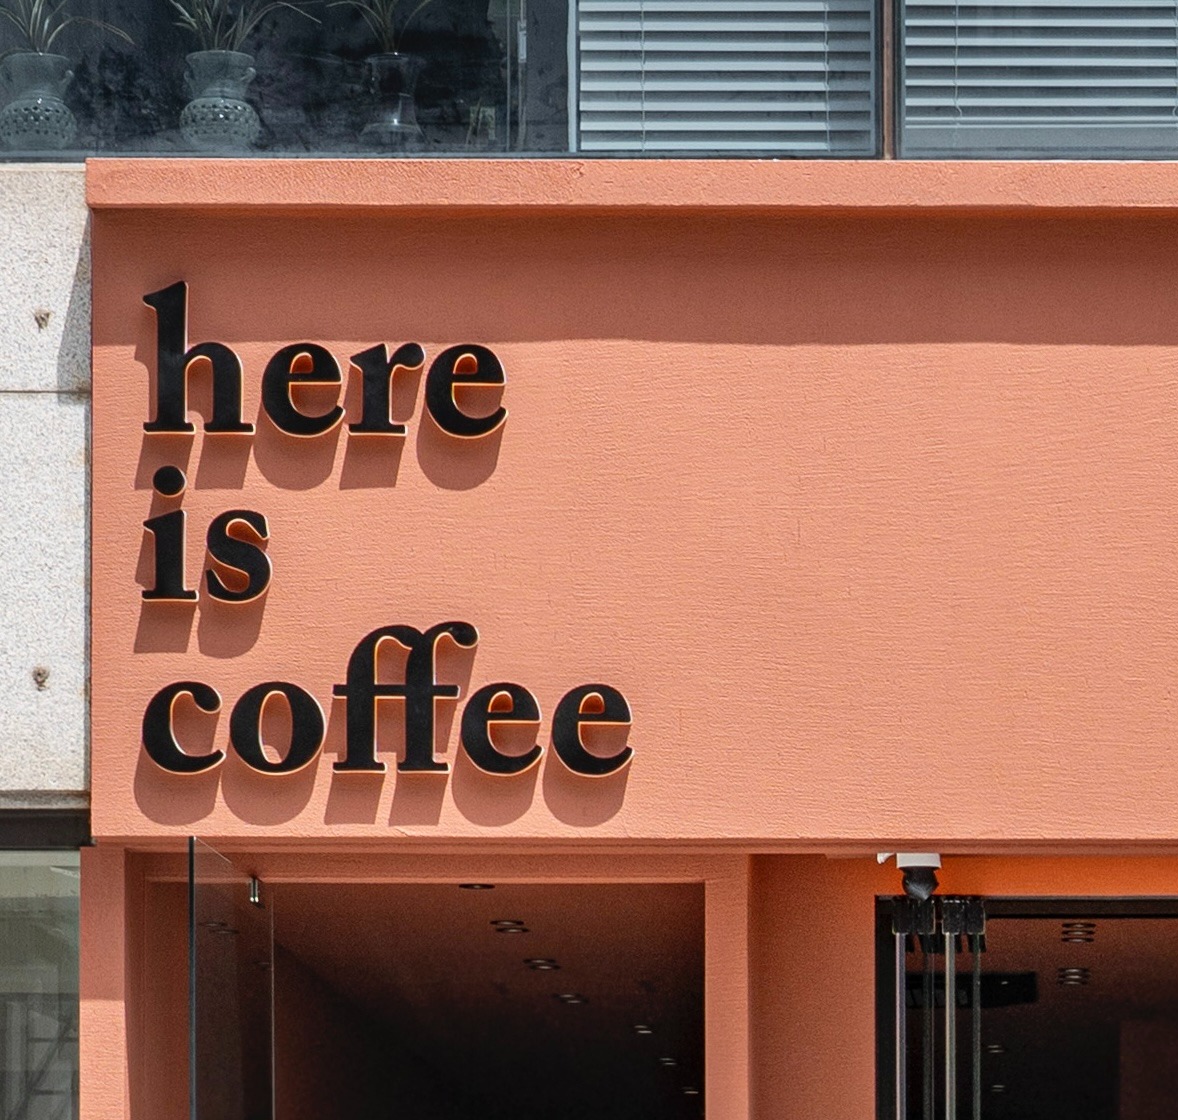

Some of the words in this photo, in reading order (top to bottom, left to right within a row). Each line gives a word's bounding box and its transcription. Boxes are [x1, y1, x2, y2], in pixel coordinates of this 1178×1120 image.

[143, 281, 508, 436] here
[143, 466, 272, 603] is
[143, 622, 633, 775] coffee
